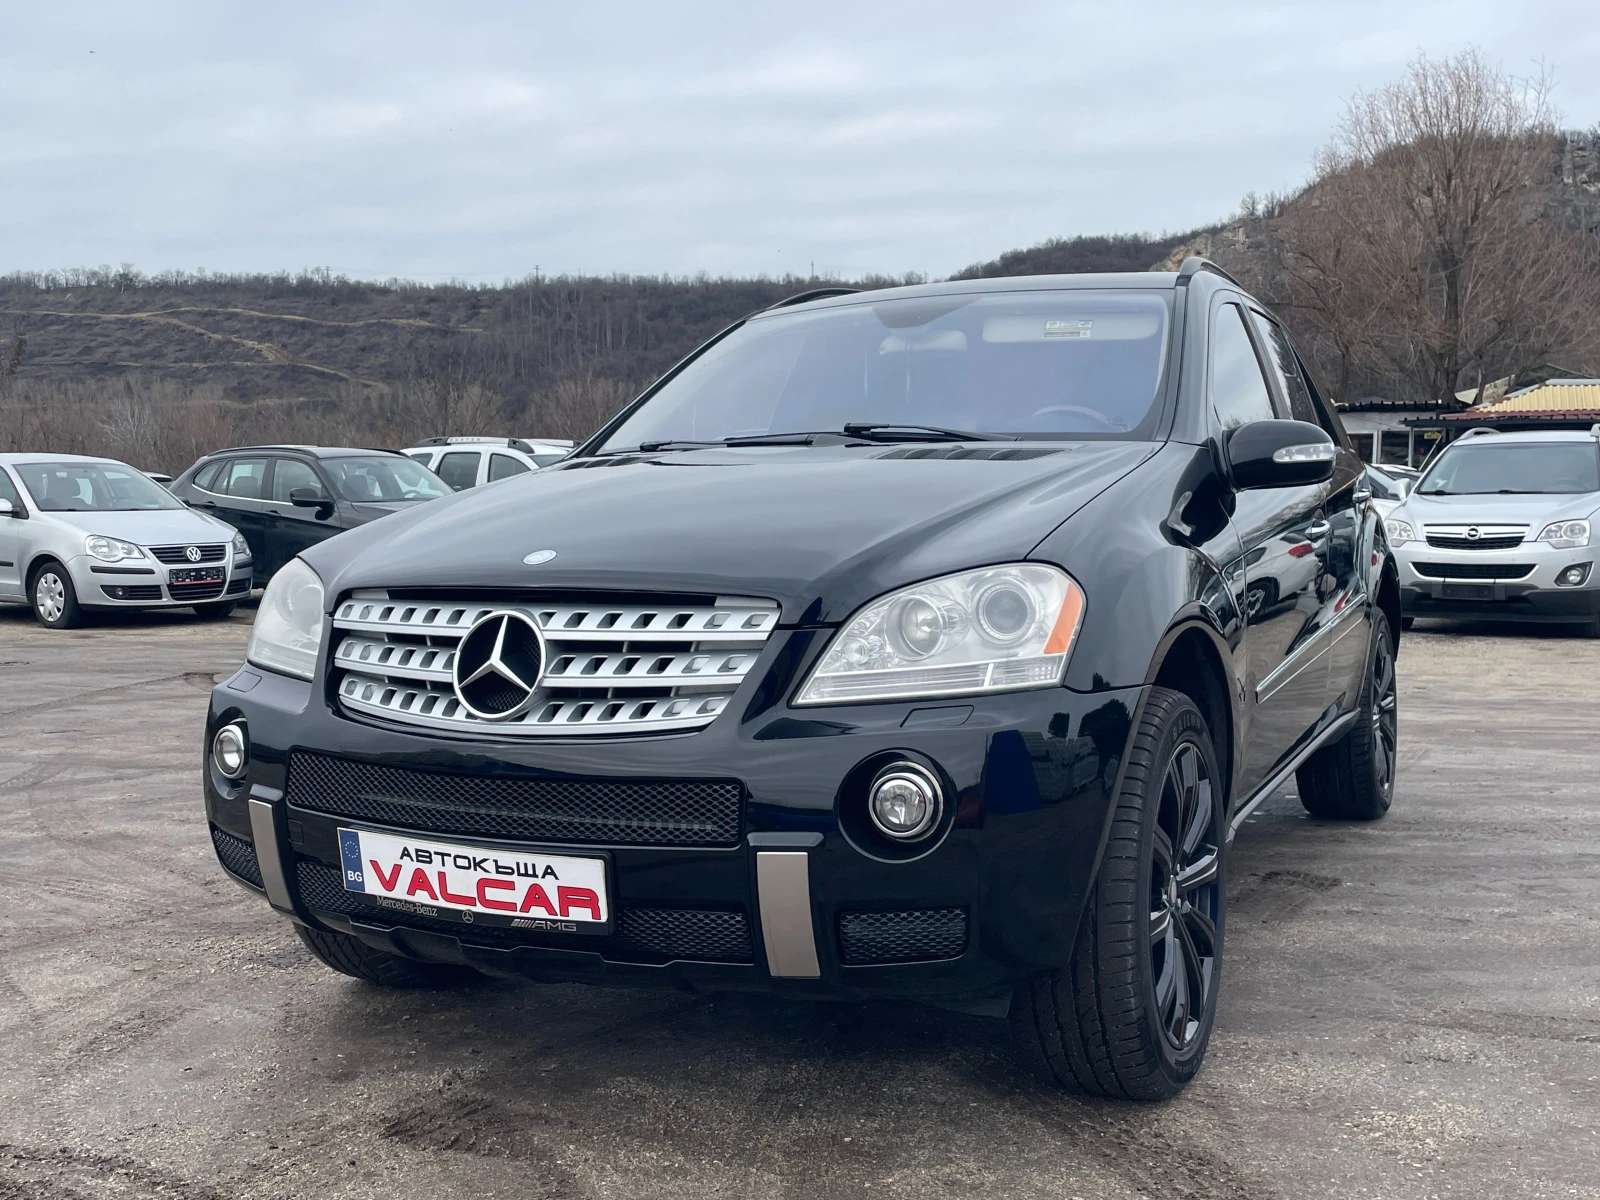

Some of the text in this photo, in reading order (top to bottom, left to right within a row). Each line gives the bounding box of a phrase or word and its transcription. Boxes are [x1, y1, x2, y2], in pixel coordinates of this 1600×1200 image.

[347, 870, 363, 882] BG
[369, 859, 602, 920] VALCAR
[376, 895, 438, 917] Mercedes-Benz
[531, 920, 577, 932] AMG
